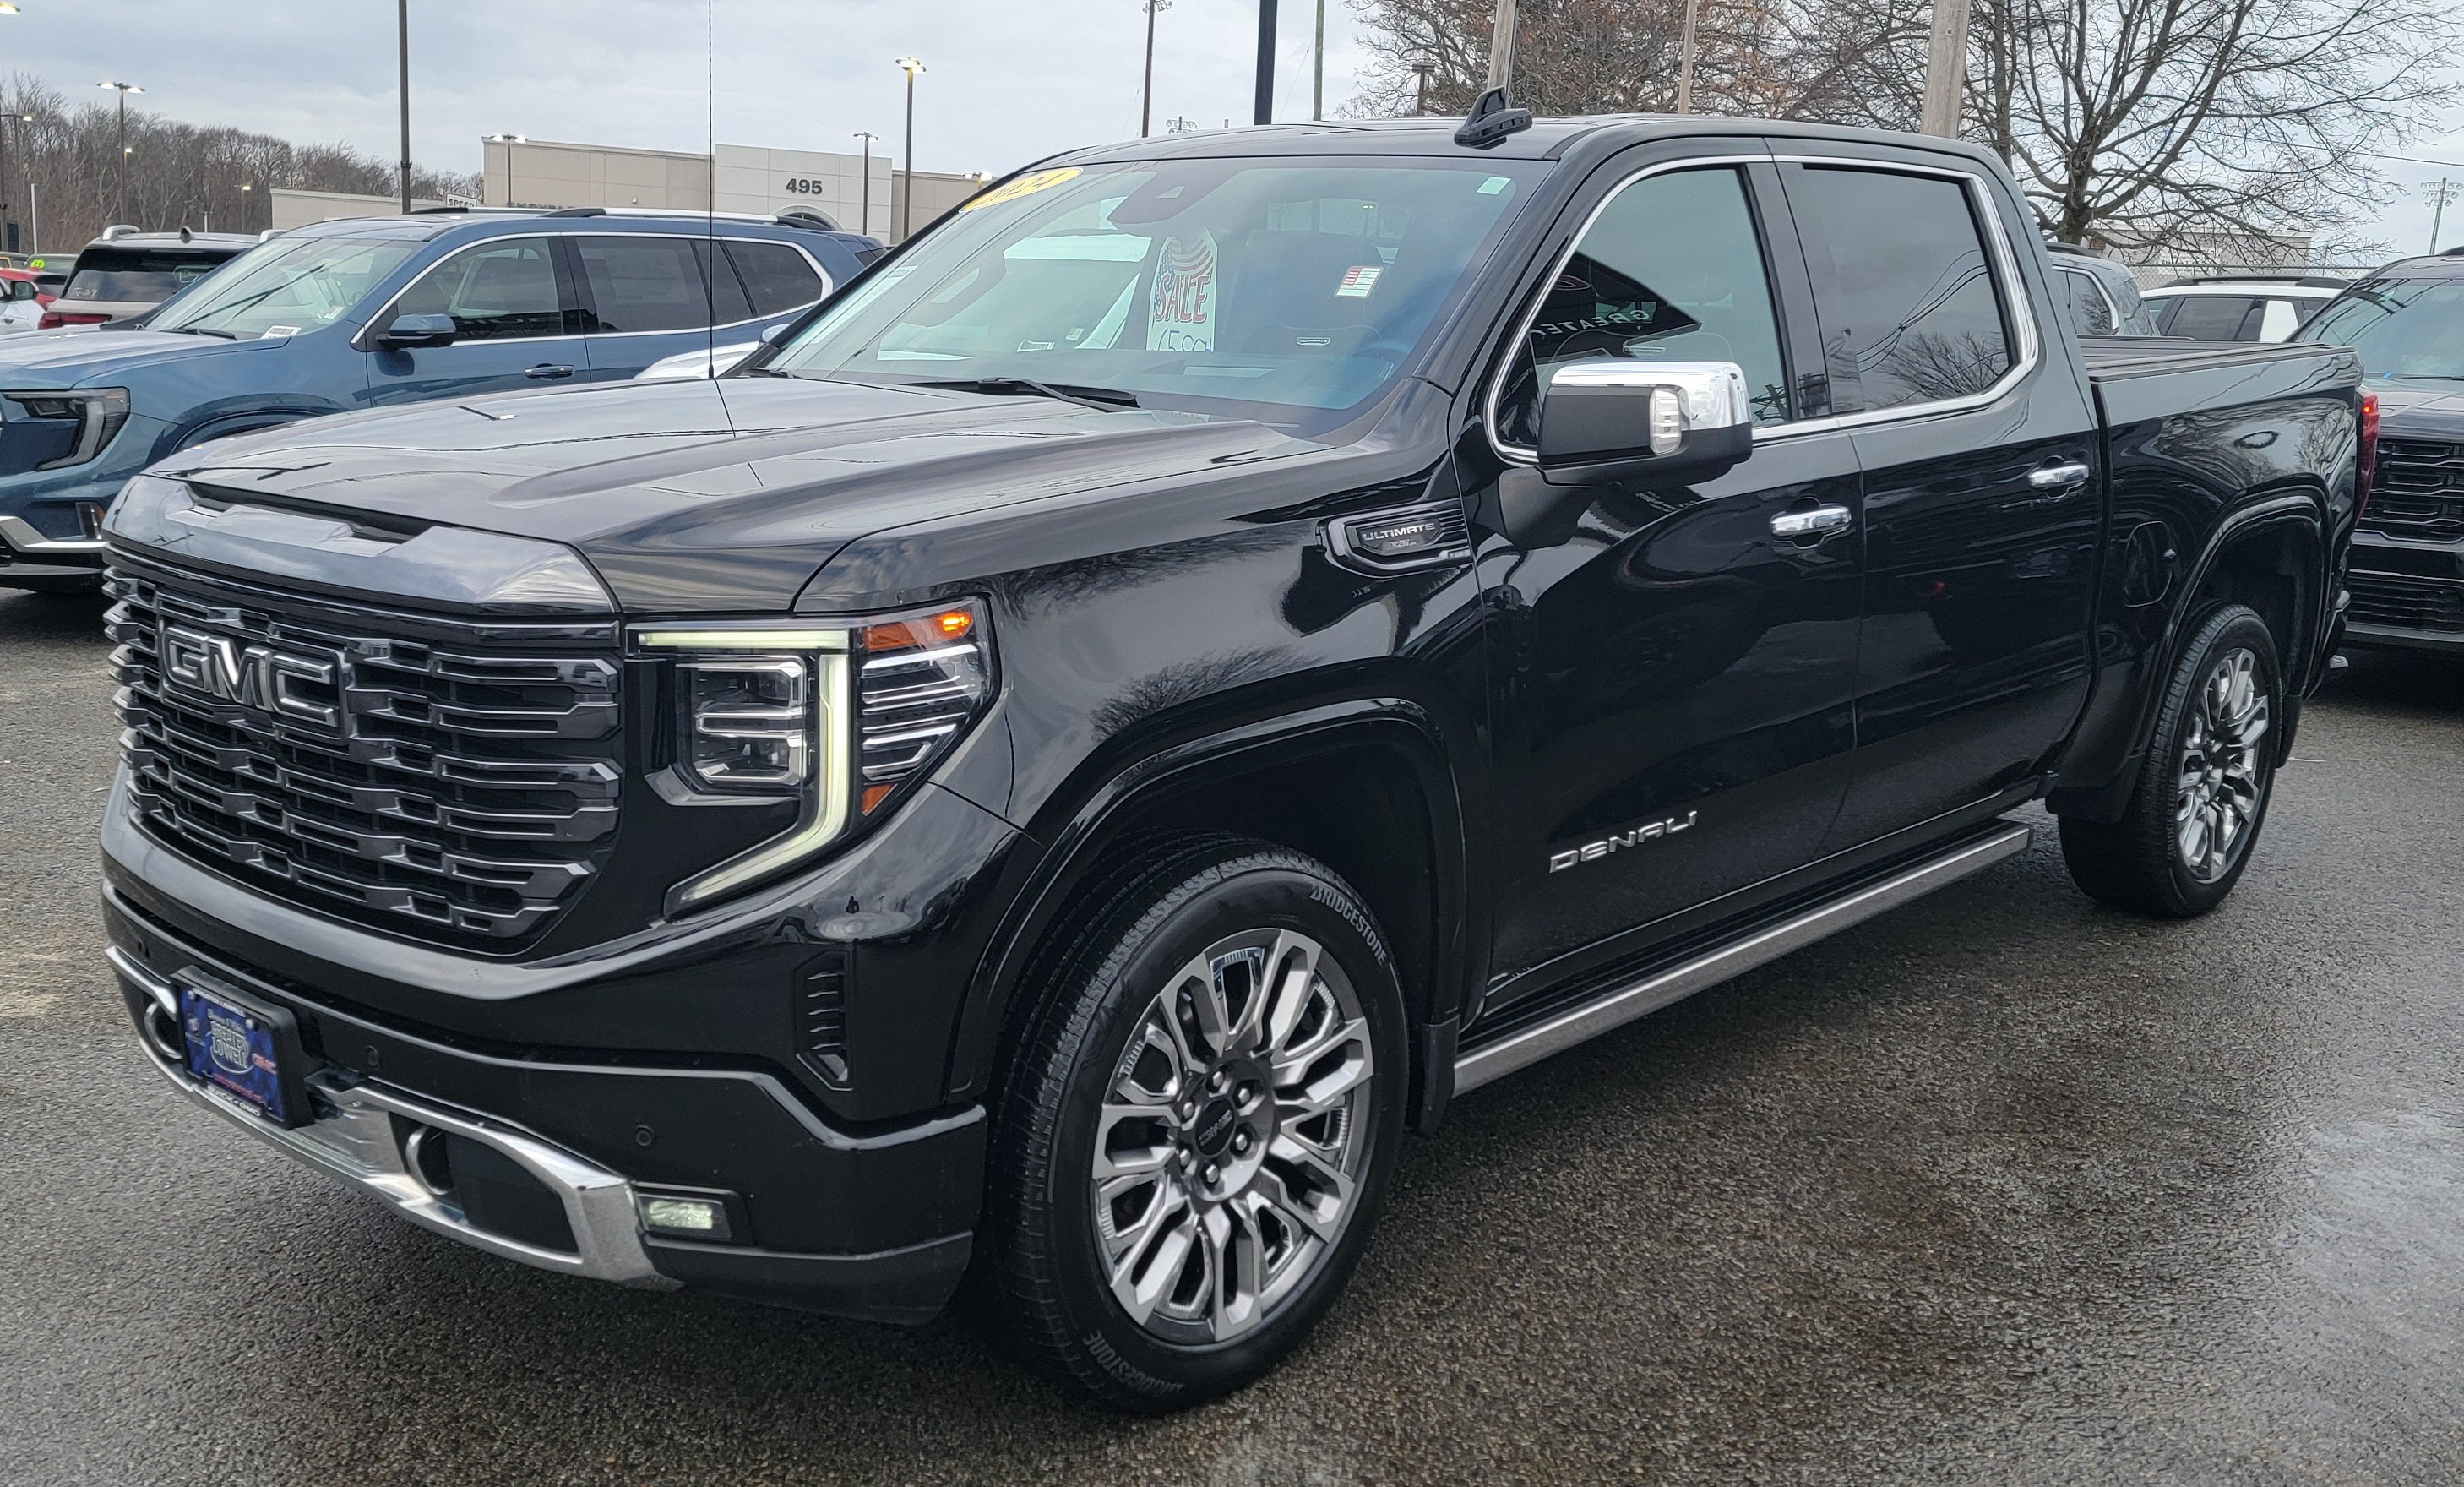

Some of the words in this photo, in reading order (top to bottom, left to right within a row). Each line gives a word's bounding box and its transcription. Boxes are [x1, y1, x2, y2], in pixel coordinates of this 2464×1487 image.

[449, 199, 475, 207] SPEED
[786, 178, 823, 195] 495
[1155, 273, 1212, 324] SALE
[1363, 522, 1436, 541] ULTIMATE
[162, 627, 338, 727] GMC
[1549, 810, 1697, 874] DENALI
[1309, 883, 1387, 966] BRIDGESTONE
[212, 1036, 248, 1070] LOWELL
